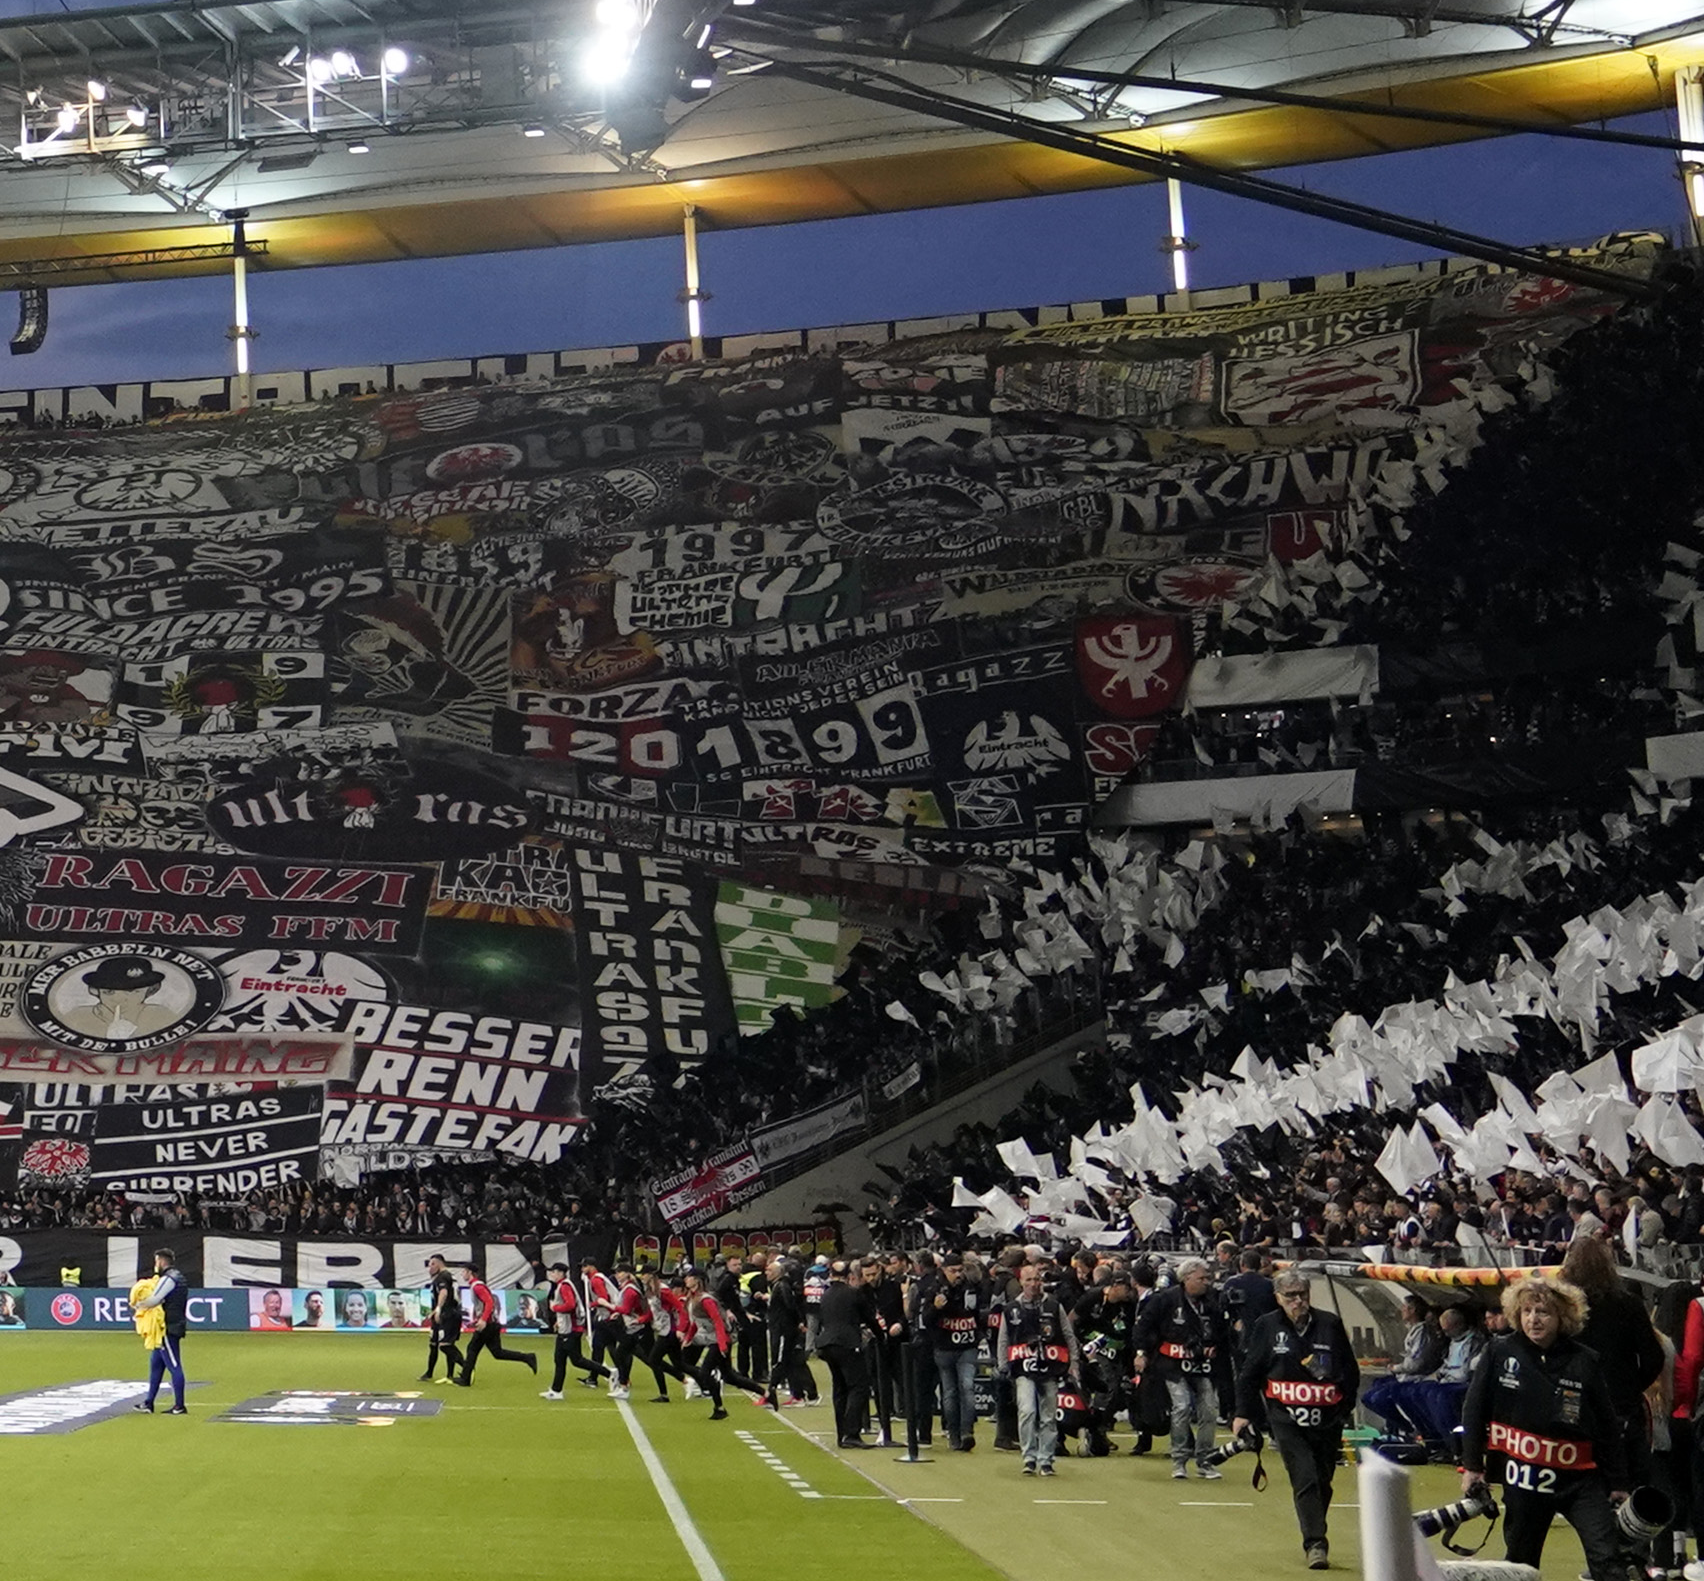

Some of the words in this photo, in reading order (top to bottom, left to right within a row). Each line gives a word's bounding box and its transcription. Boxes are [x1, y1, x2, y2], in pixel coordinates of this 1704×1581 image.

[17, 585, 186, 620] SINCE
[226, 568, 384, 612] 1995
[516, 680, 693, 720] FORZA
[696, 700, 918, 769] 1899
[413, 792, 530, 830] ras
[910, 837, 1056, 858] EXTREME
[36, 853, 415, 909] RAGAZZI
[26, 903, 247, 937] ULTRAS
[270, 915, 401, 943] FFM
[29, 960, 65, 996] MER
[65, 942, 168, 968] BABBELN
[172, 951, 217, 982] NET
[240, 976, 348, 998] Eintracht
[38, 1019, 79, 1051] MIT
[341, 1000, 583, 1071] BESSER
[356, 1048, 550, 1114] RENN
[142, 1096, 283, 1130] ULTRAS
[155, 1130, 270, 1164] NEVER
[93, 1297, 224, 1322] RECT
[951, 1331, 976, 1345] 023
[1271, 1381, 1336, 1405] PHOTO
[1491, 1423, 1578, 1466] PHOTO
[1506, 1459, 1557, 1494] 012
